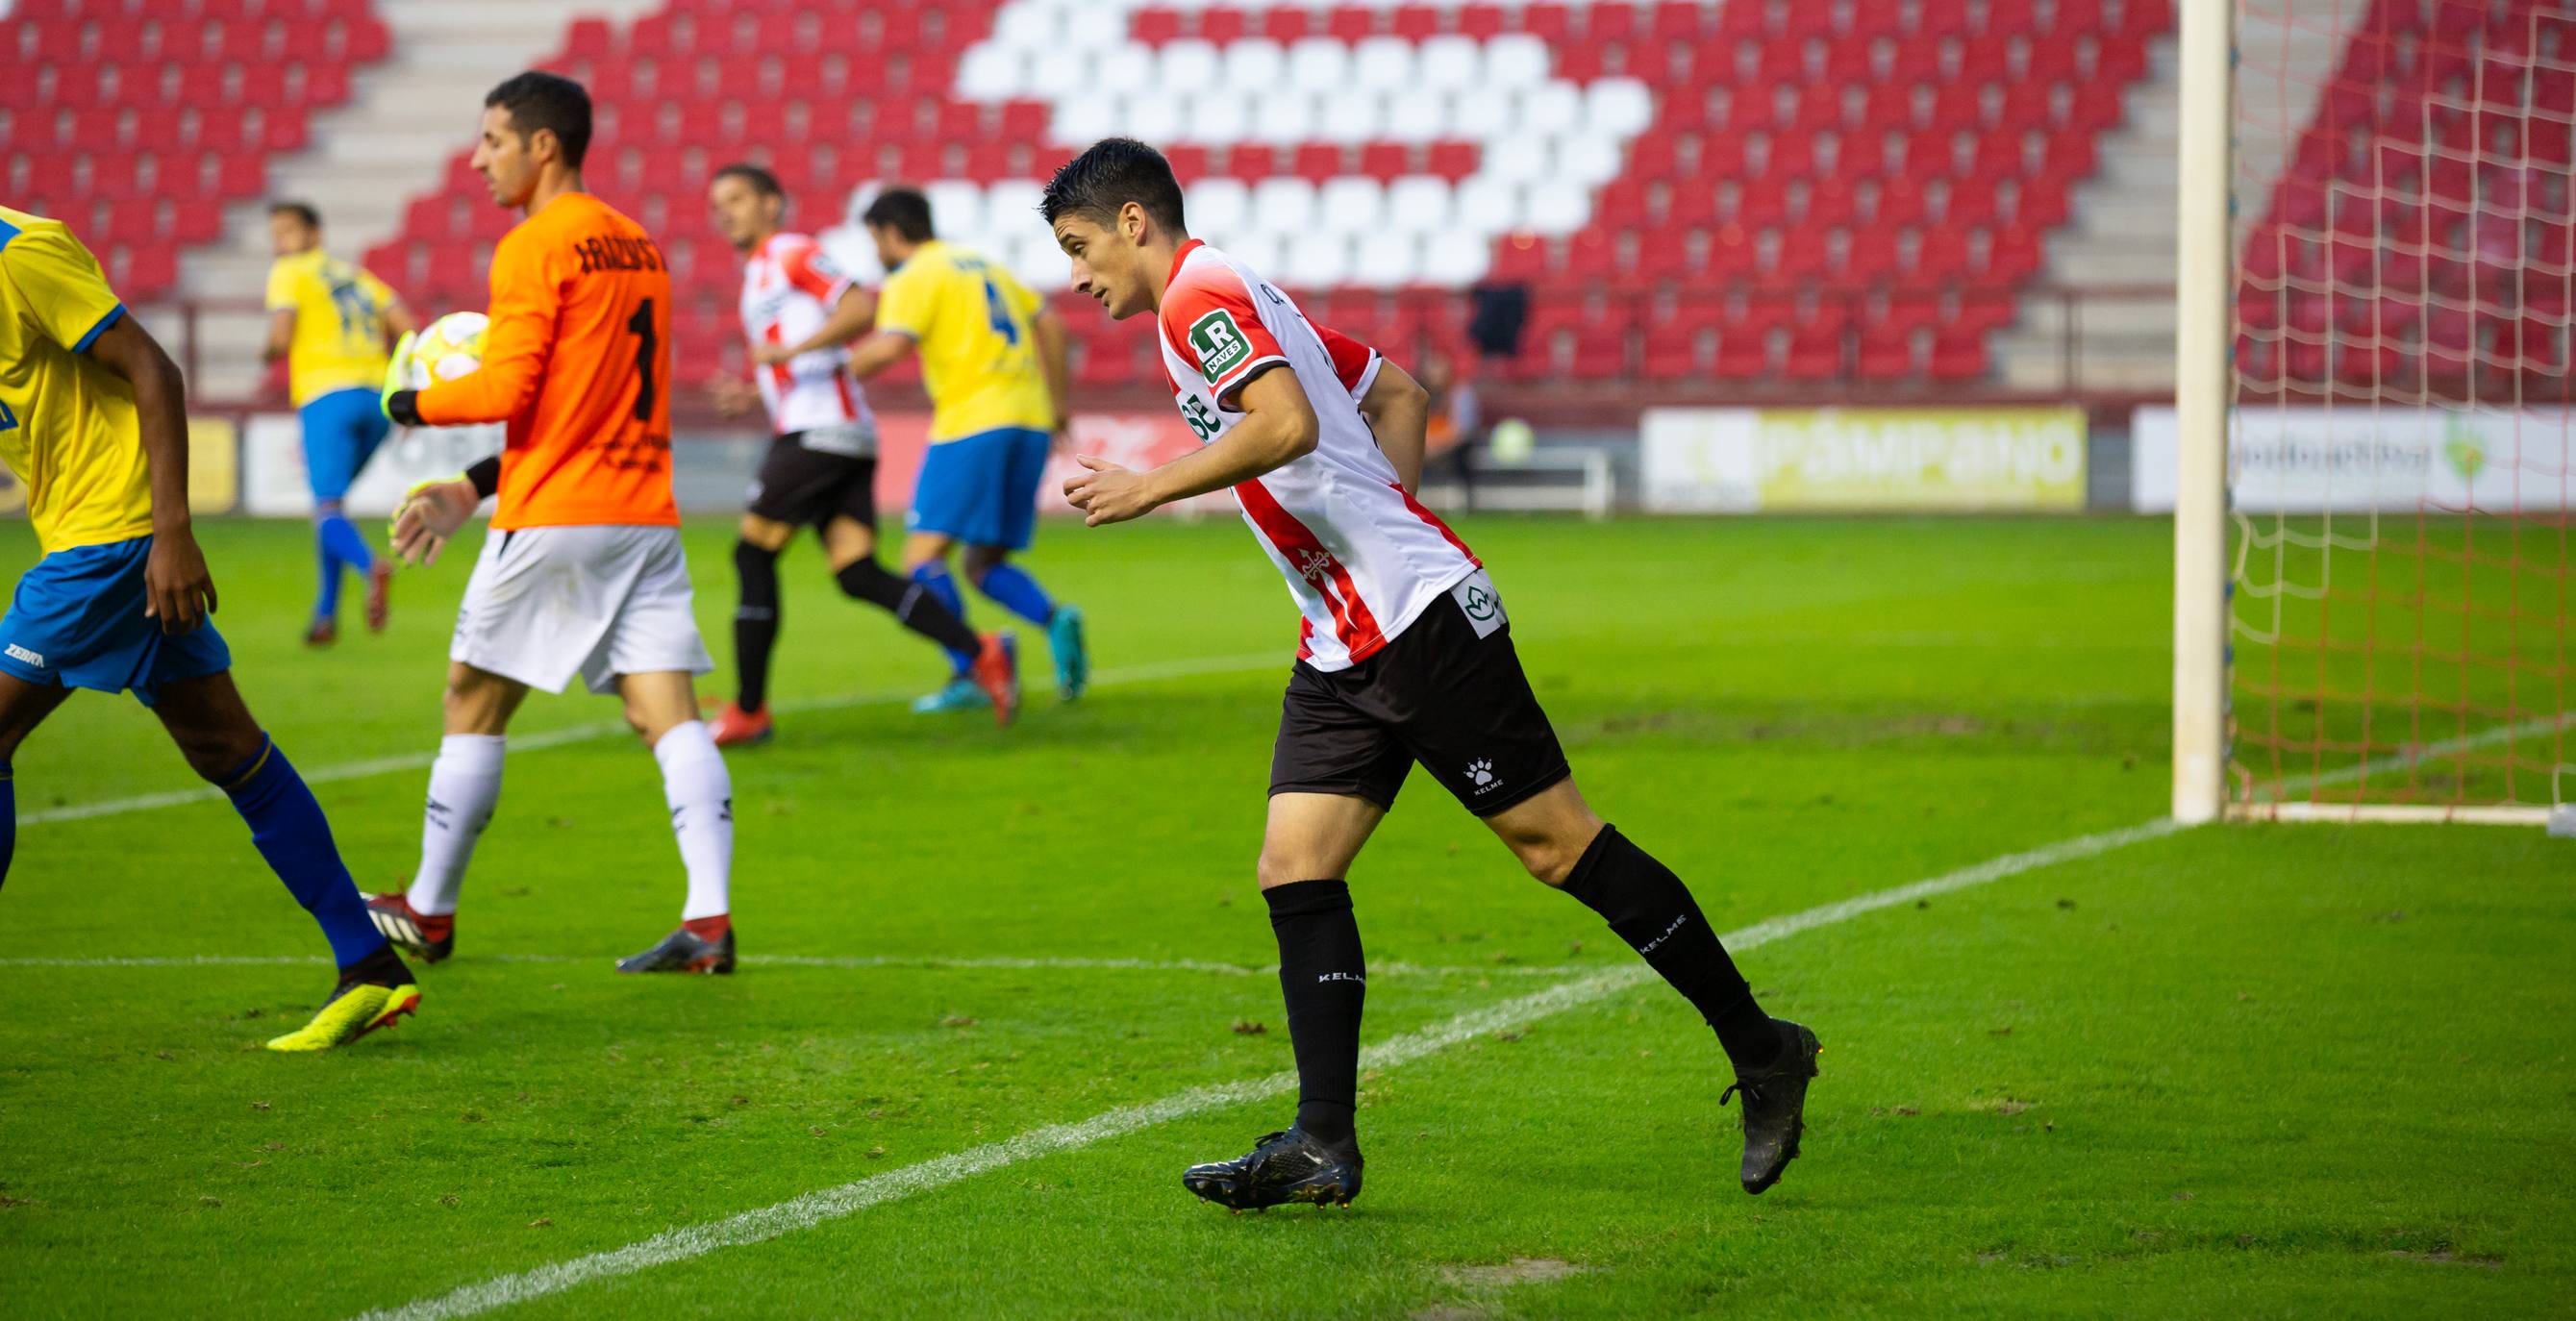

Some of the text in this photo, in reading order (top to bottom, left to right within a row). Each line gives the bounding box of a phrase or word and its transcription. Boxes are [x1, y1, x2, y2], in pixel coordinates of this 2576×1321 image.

[984, 280, 1017, 346] 4
[628, 298, 657, 422] 1
[1192, 320, 1235, 362] LR
[1209, 342, 1241, 373] NAVES
[4, 643, 44, 667] ZEBRA
[1474, 779, 1503, 796] KELME
[1639, 914, 1687, 954] KELME
